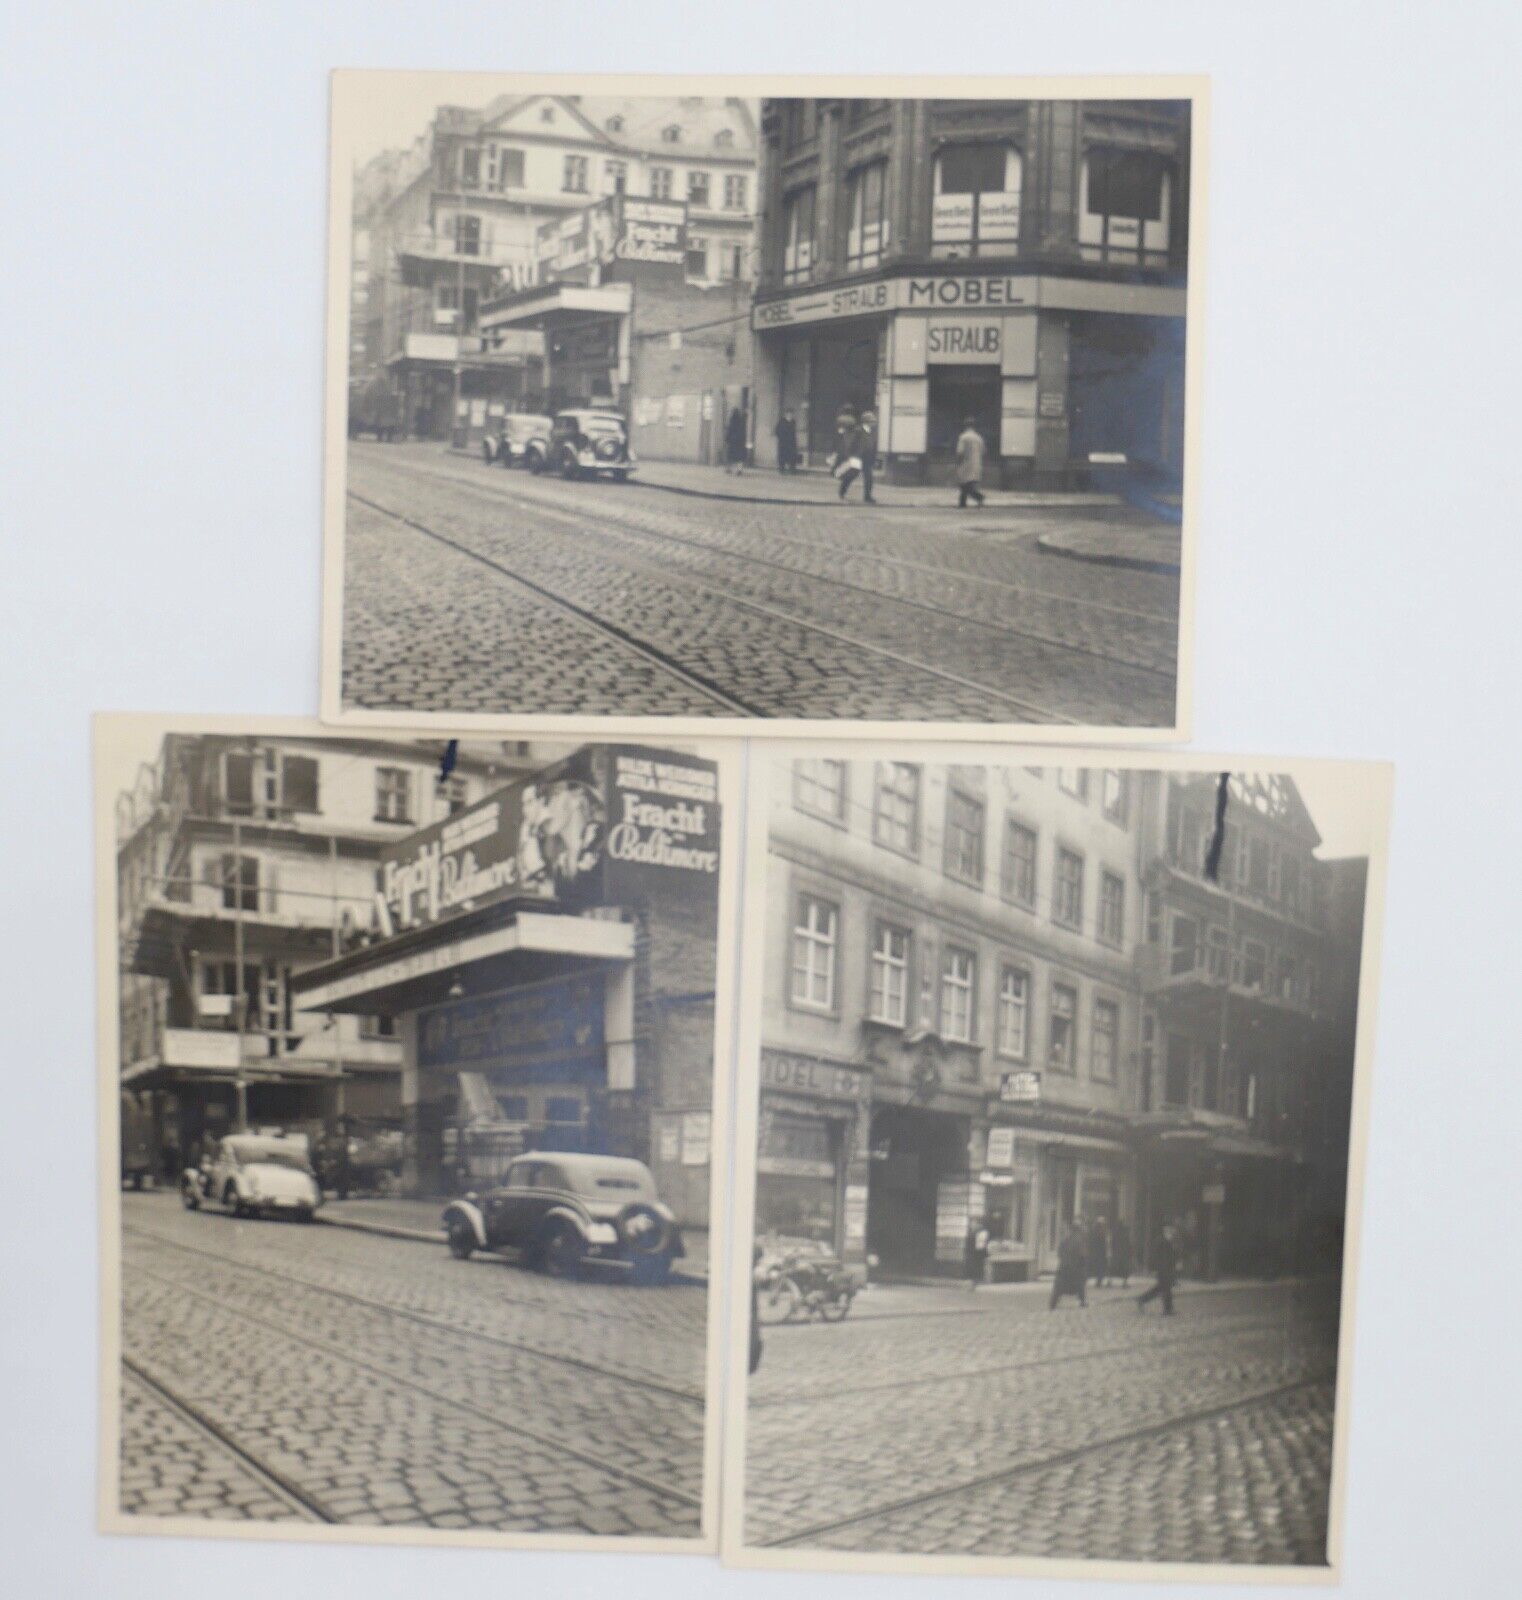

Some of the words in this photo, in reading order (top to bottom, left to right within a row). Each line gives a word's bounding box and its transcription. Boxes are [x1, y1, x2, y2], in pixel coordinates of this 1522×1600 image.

[928, 326, 1000, 353] STRAUB
[622, 793, 706, 835] Fracht
[608, 823, 719, 873] Baltimore
